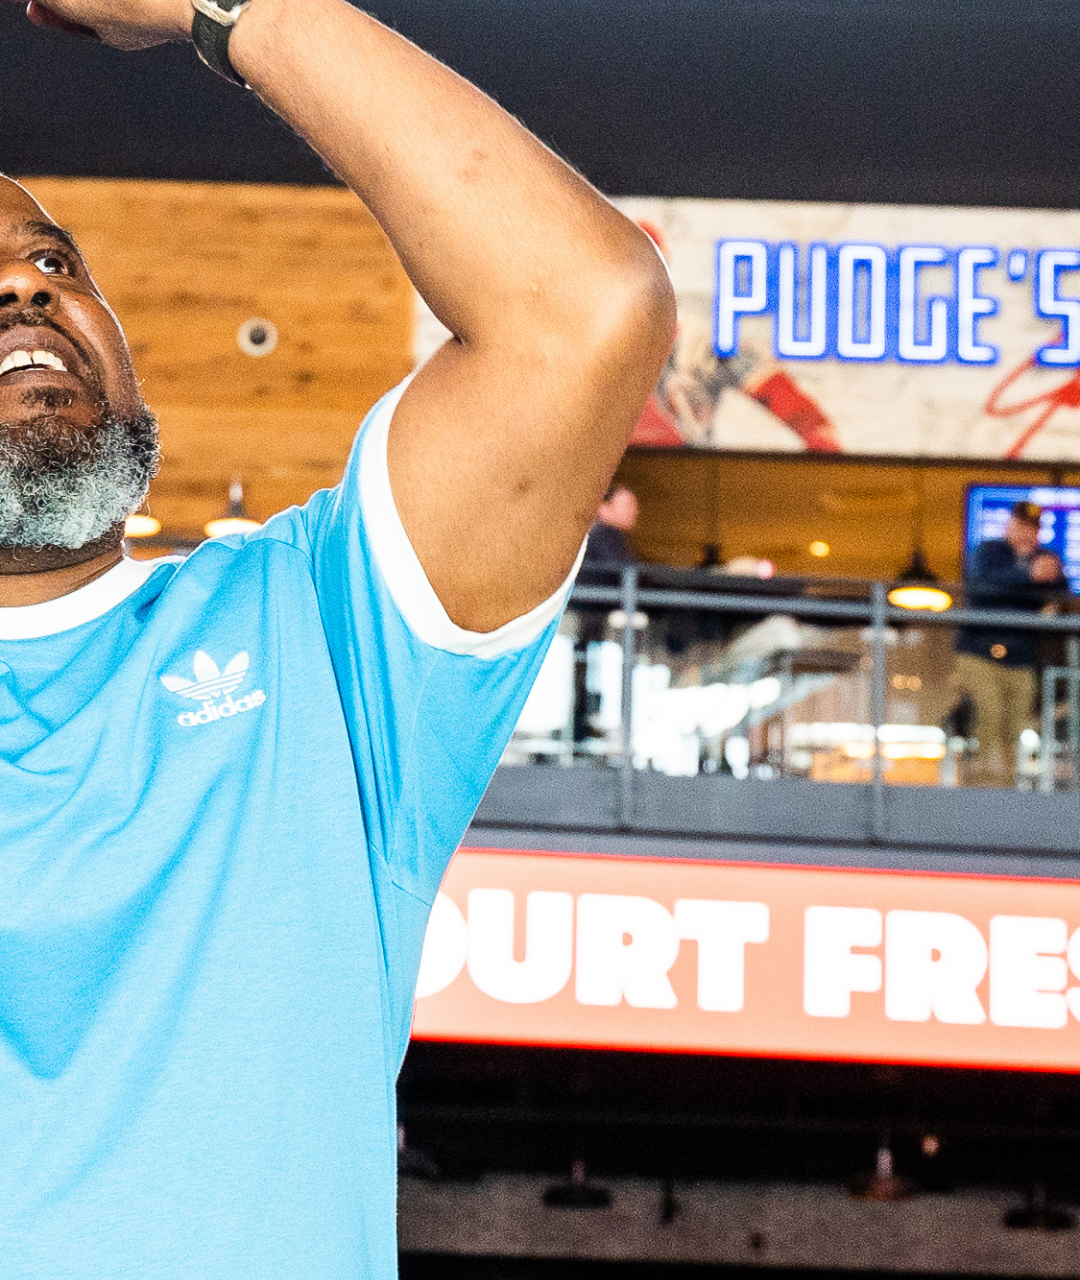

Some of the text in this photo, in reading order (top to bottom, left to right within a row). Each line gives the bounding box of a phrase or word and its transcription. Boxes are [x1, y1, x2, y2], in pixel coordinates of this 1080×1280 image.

[715, 239, 1080, 367] PUDGE'S
[177, 689, 267, 727] adidas
[803, 905, 1080, 1030] FRE
